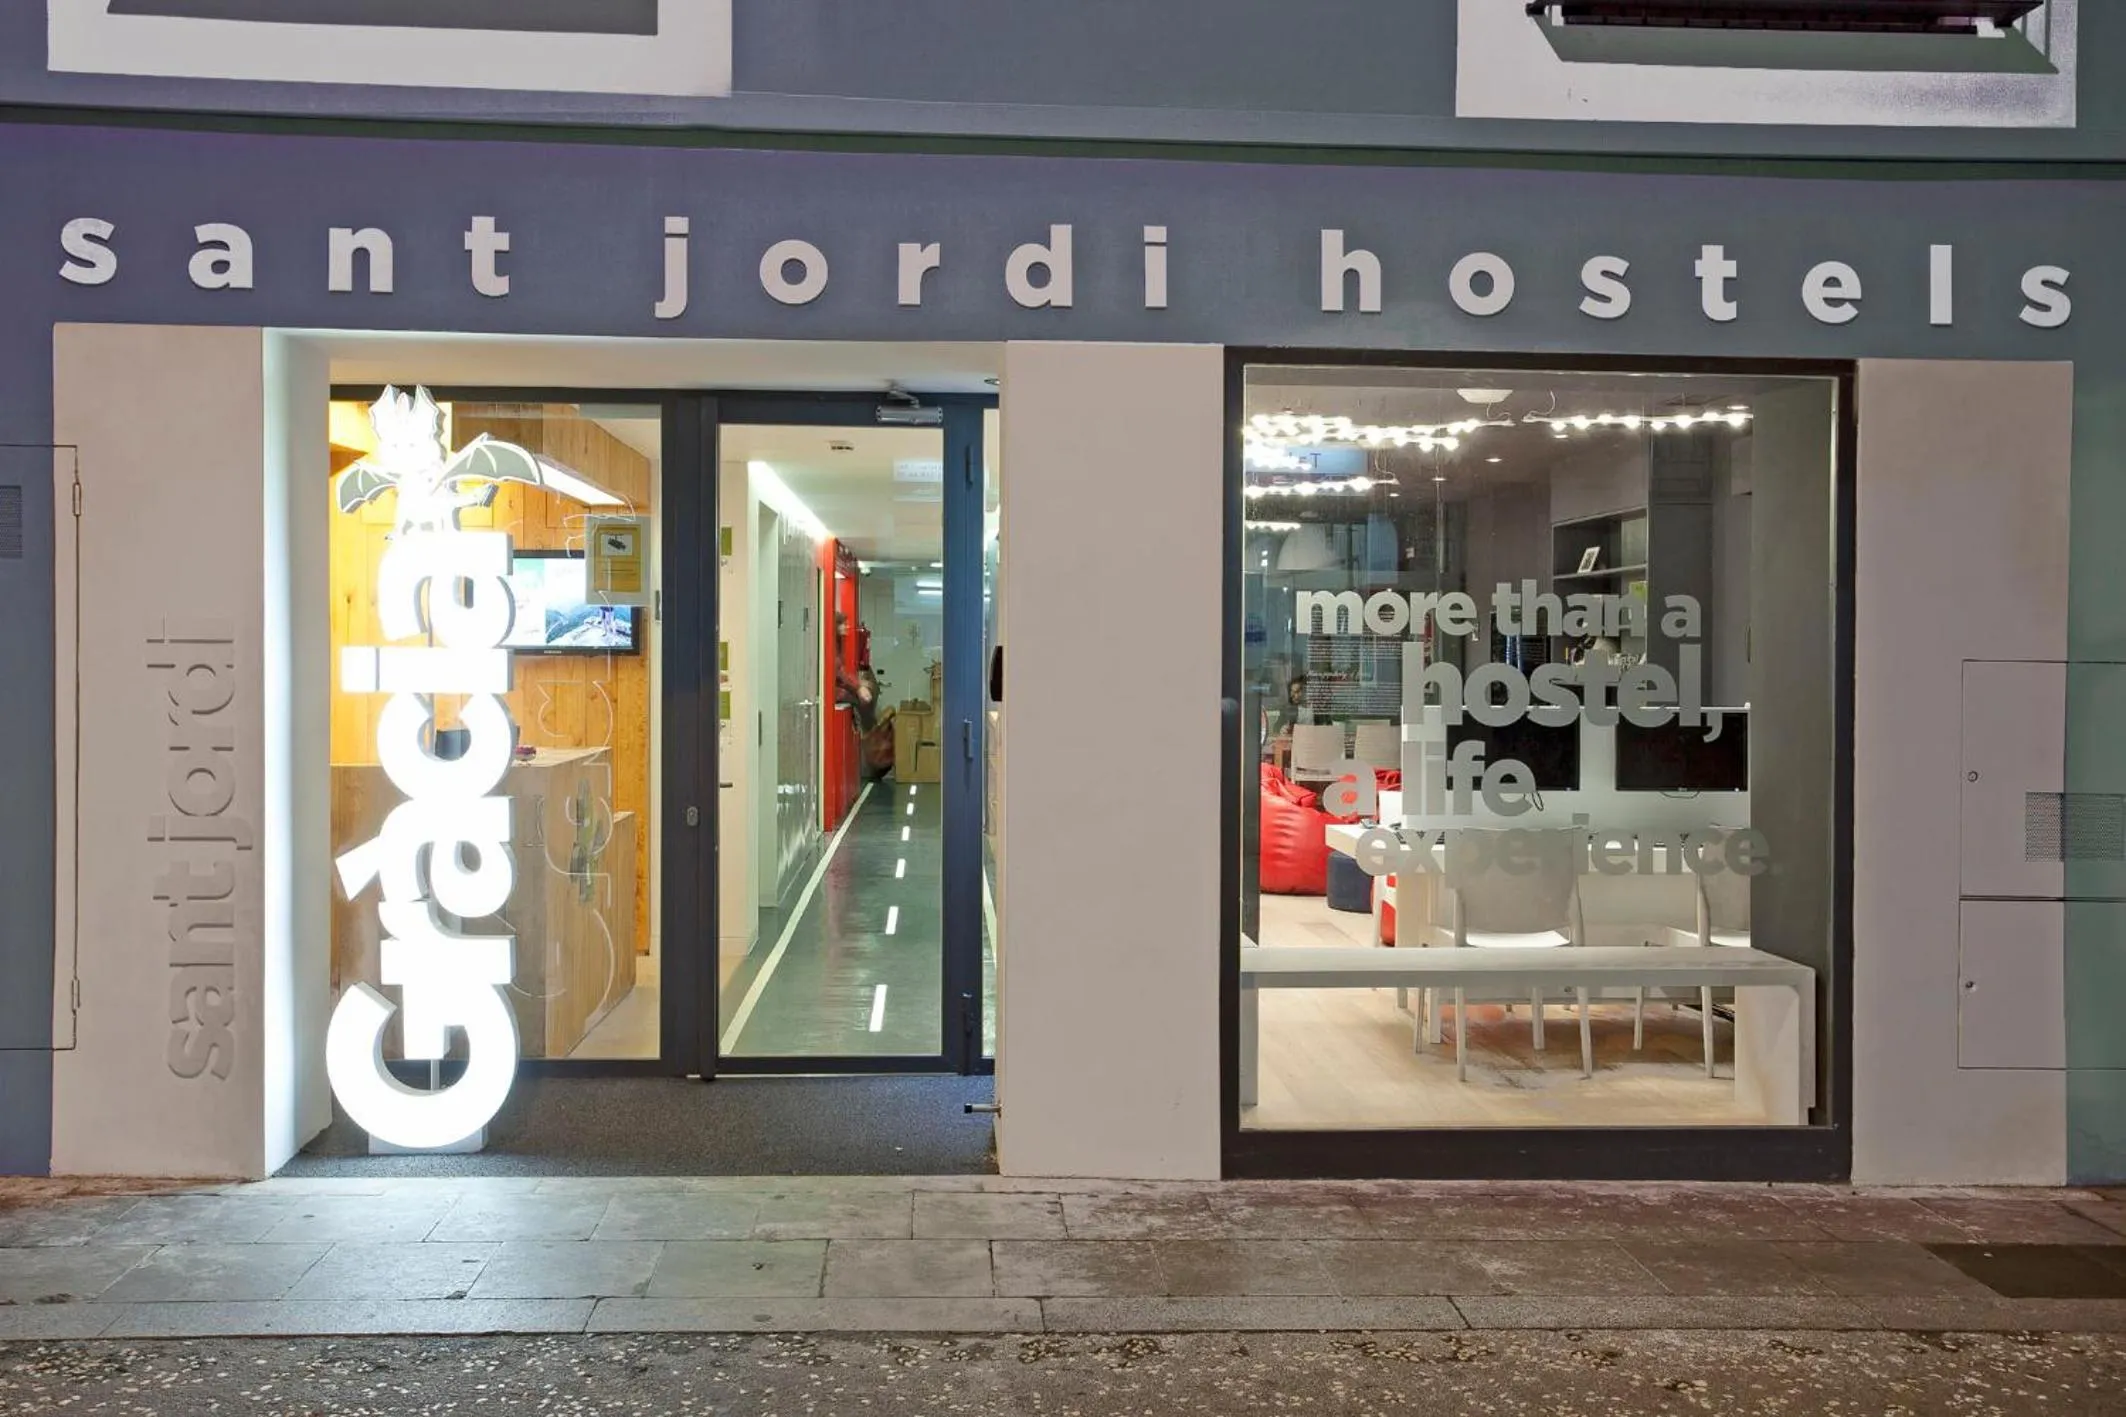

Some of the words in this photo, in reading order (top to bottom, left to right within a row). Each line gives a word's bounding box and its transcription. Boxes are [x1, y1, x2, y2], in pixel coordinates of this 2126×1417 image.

[58, 216, 511, 297] sant
[654, 216, 1167, 318] jordi
[1321, 228, 2073, 328] hostels
[1295, 587, 1478, 637] more
[1491, 579, 1647, 638] than
[1660, 593, 1701, 638] a
[146, 615, 254, 851] jordi
[1401, 641, 1723, 743] hostel,
[1322, 757, 1377, 816] a
[1400, 739, 1536, 818] life
[325, 532, 519, 1148] Gràcia
[152, 859, 236, 1081] sant
